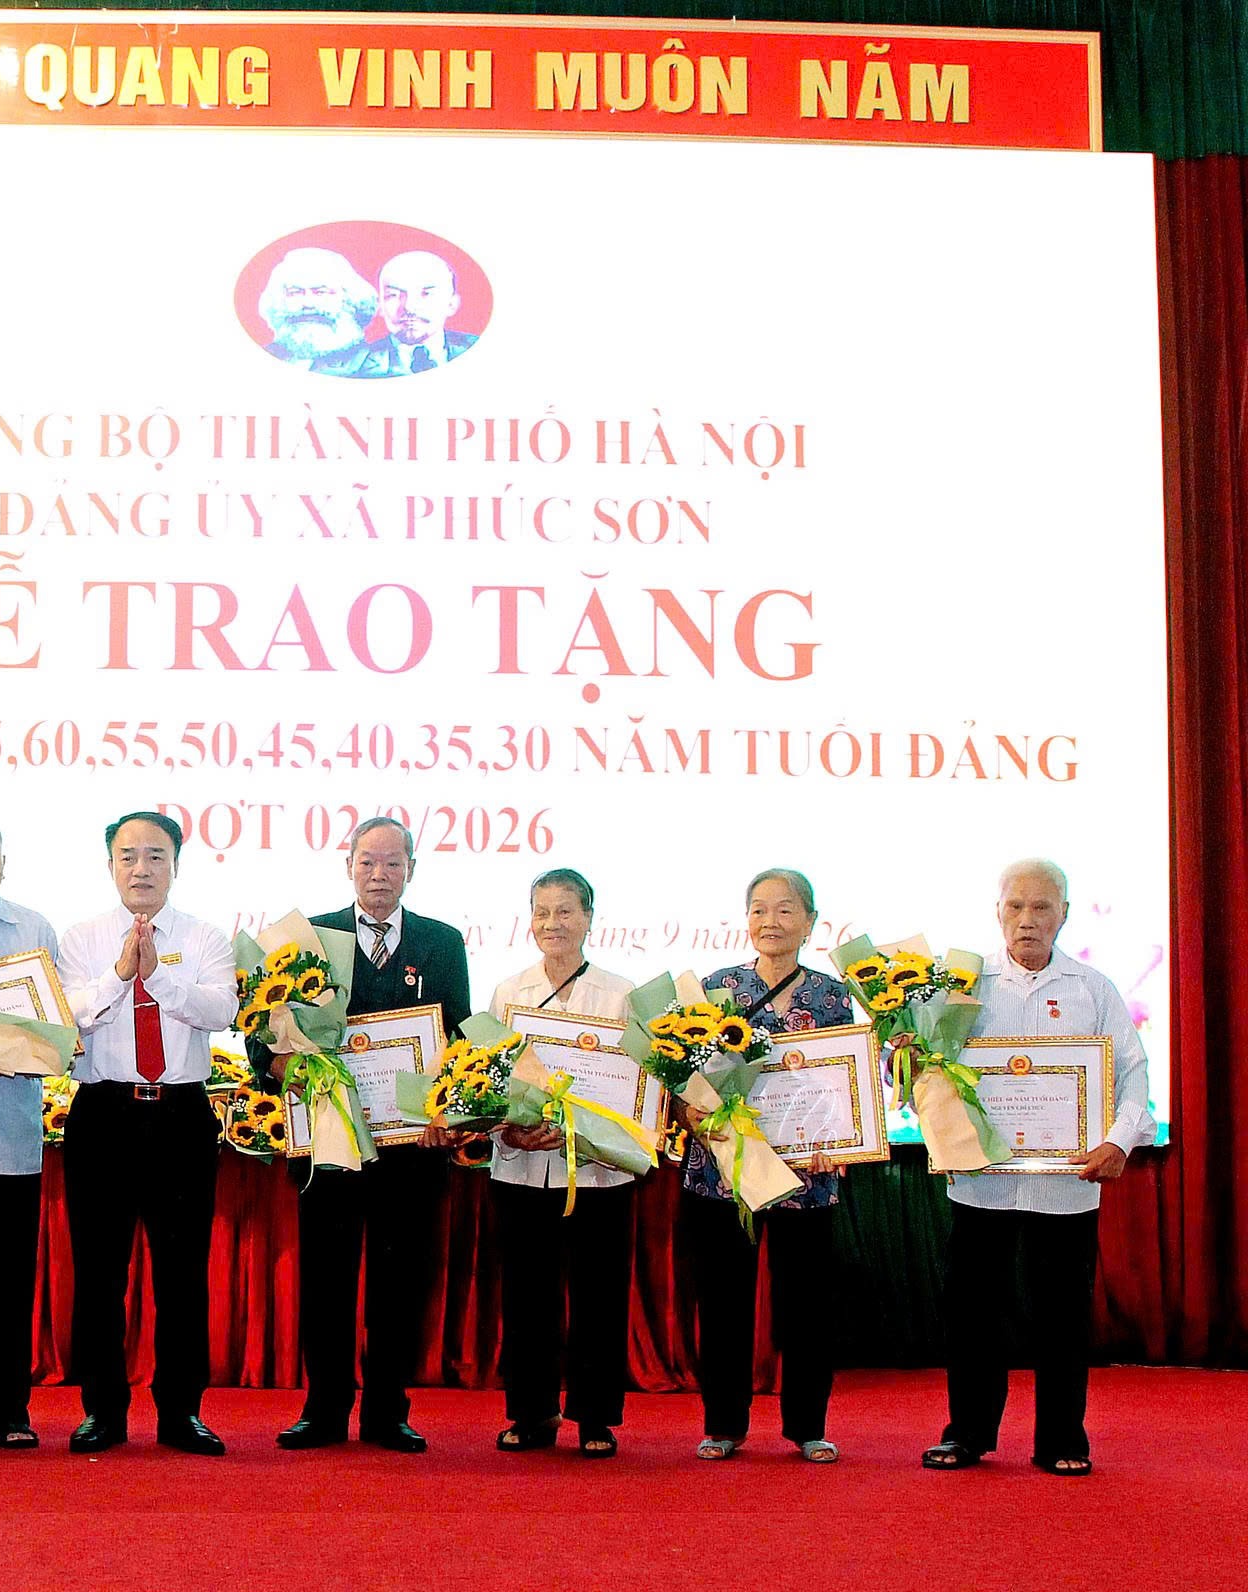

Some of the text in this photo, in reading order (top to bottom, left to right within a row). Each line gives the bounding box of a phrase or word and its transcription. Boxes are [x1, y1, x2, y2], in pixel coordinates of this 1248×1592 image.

[23, 43, 271, 111] QUANG
[318, 47, 493, 109] VINH
[535, 38, 748, 115] MUÔN
[99, 406, 181, 472] BỘ
[201, 402, 419, 462] THÀNH
[447, 405, 572, 464] PHỐ
[596, 409, 679, 467] HÀ
[702, 416, 808, 482] NỘI
[299, 483, 380, 541] XÃ
[406, 483, 573, 543] PHÚC
[593, 496, 713, 545] SƠN
[82, 582, 435, 676] TRAO
[472, 570, 823, 705] TẶNG
[574, 714, 713, 775] NĂM
[906, 719, 1080, 783] ĐẢNG
[304, 804, 554, 854] 02/2026
[588, 916, 649, 957] áng
